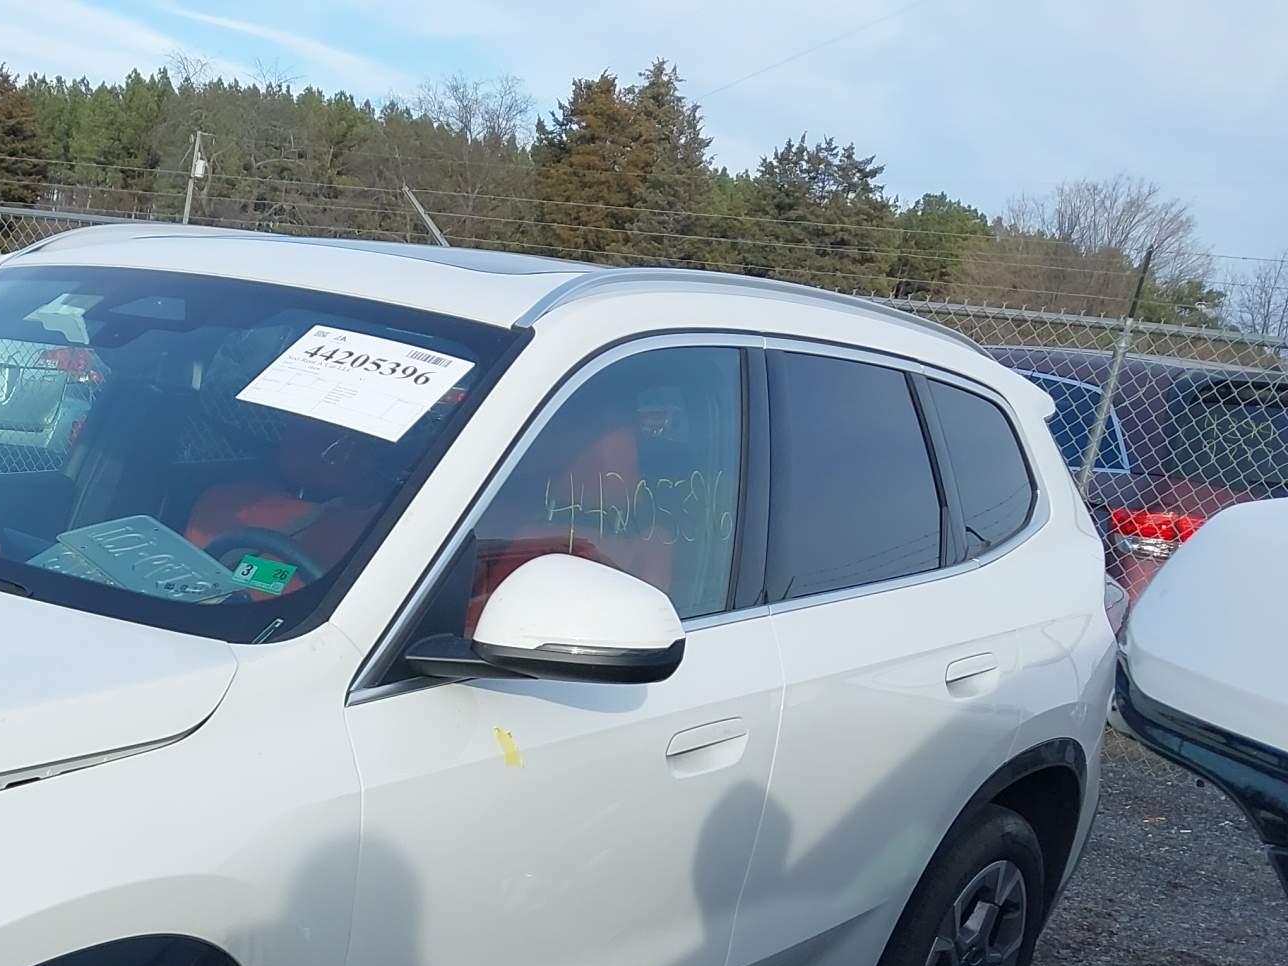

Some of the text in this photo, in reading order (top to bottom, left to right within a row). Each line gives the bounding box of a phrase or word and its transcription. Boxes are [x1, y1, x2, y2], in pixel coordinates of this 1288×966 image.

[304, 344, 438, 385] 44205396
[241, 563, 289, 581] 3 26
